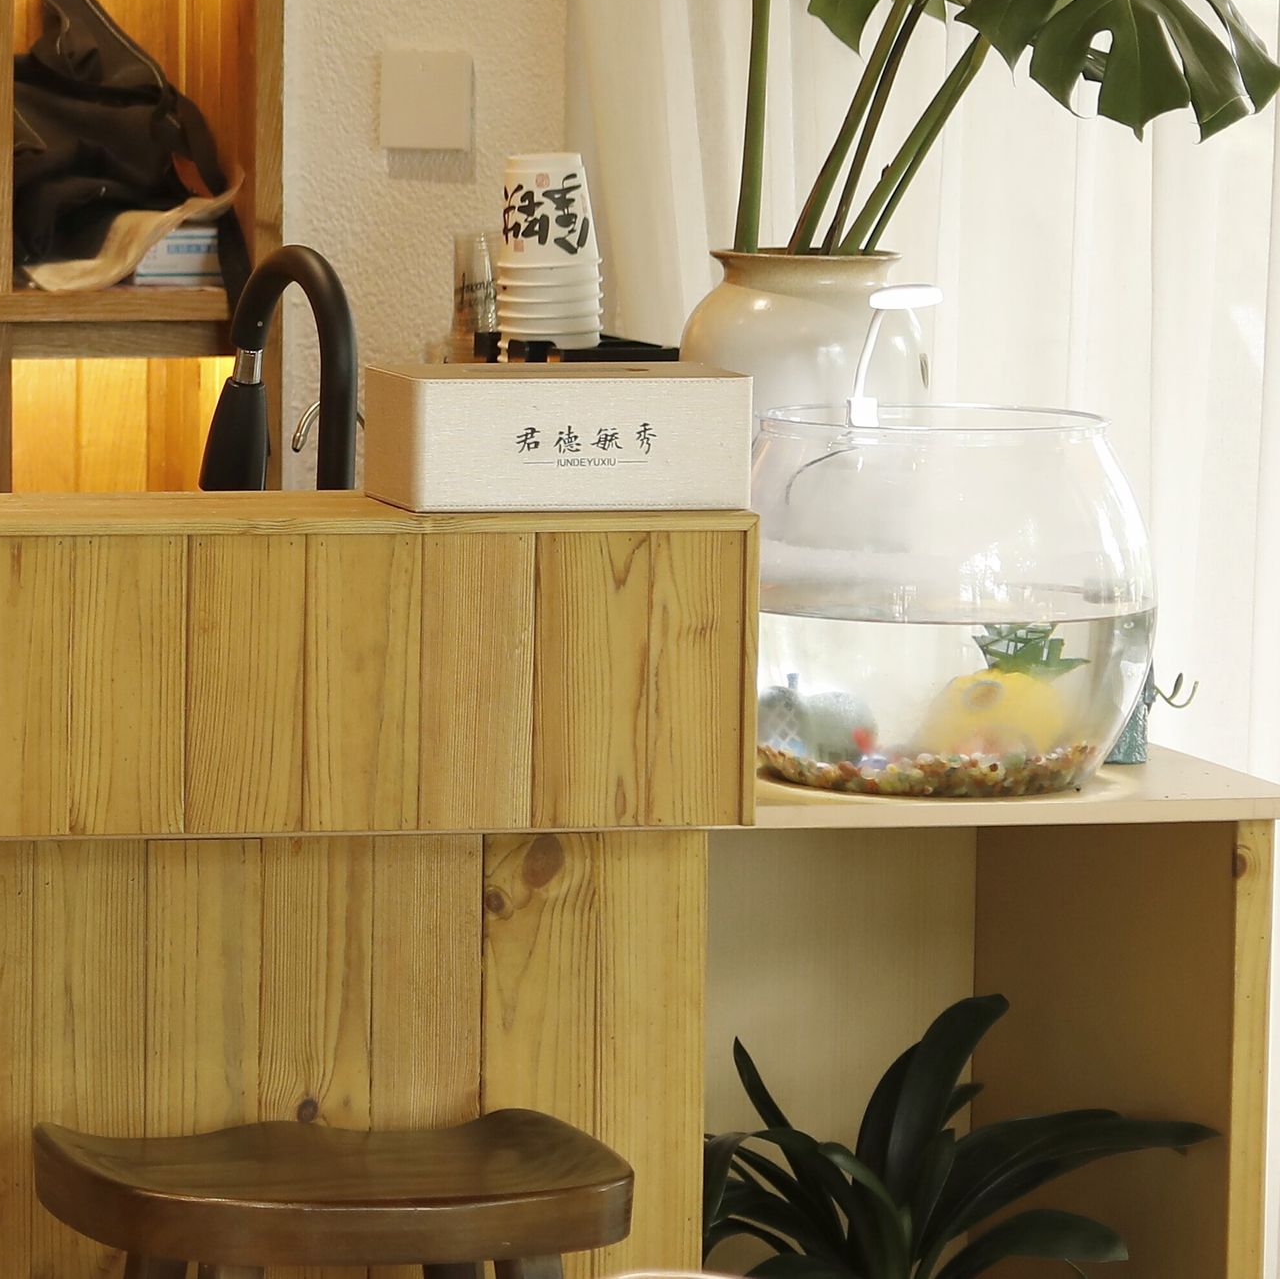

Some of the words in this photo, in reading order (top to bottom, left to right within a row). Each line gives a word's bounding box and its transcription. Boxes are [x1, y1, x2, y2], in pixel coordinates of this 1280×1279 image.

[516, 422, 657, 454] 君德毓秀
[557, 458, 616, 467] JUNDEYUXIU
